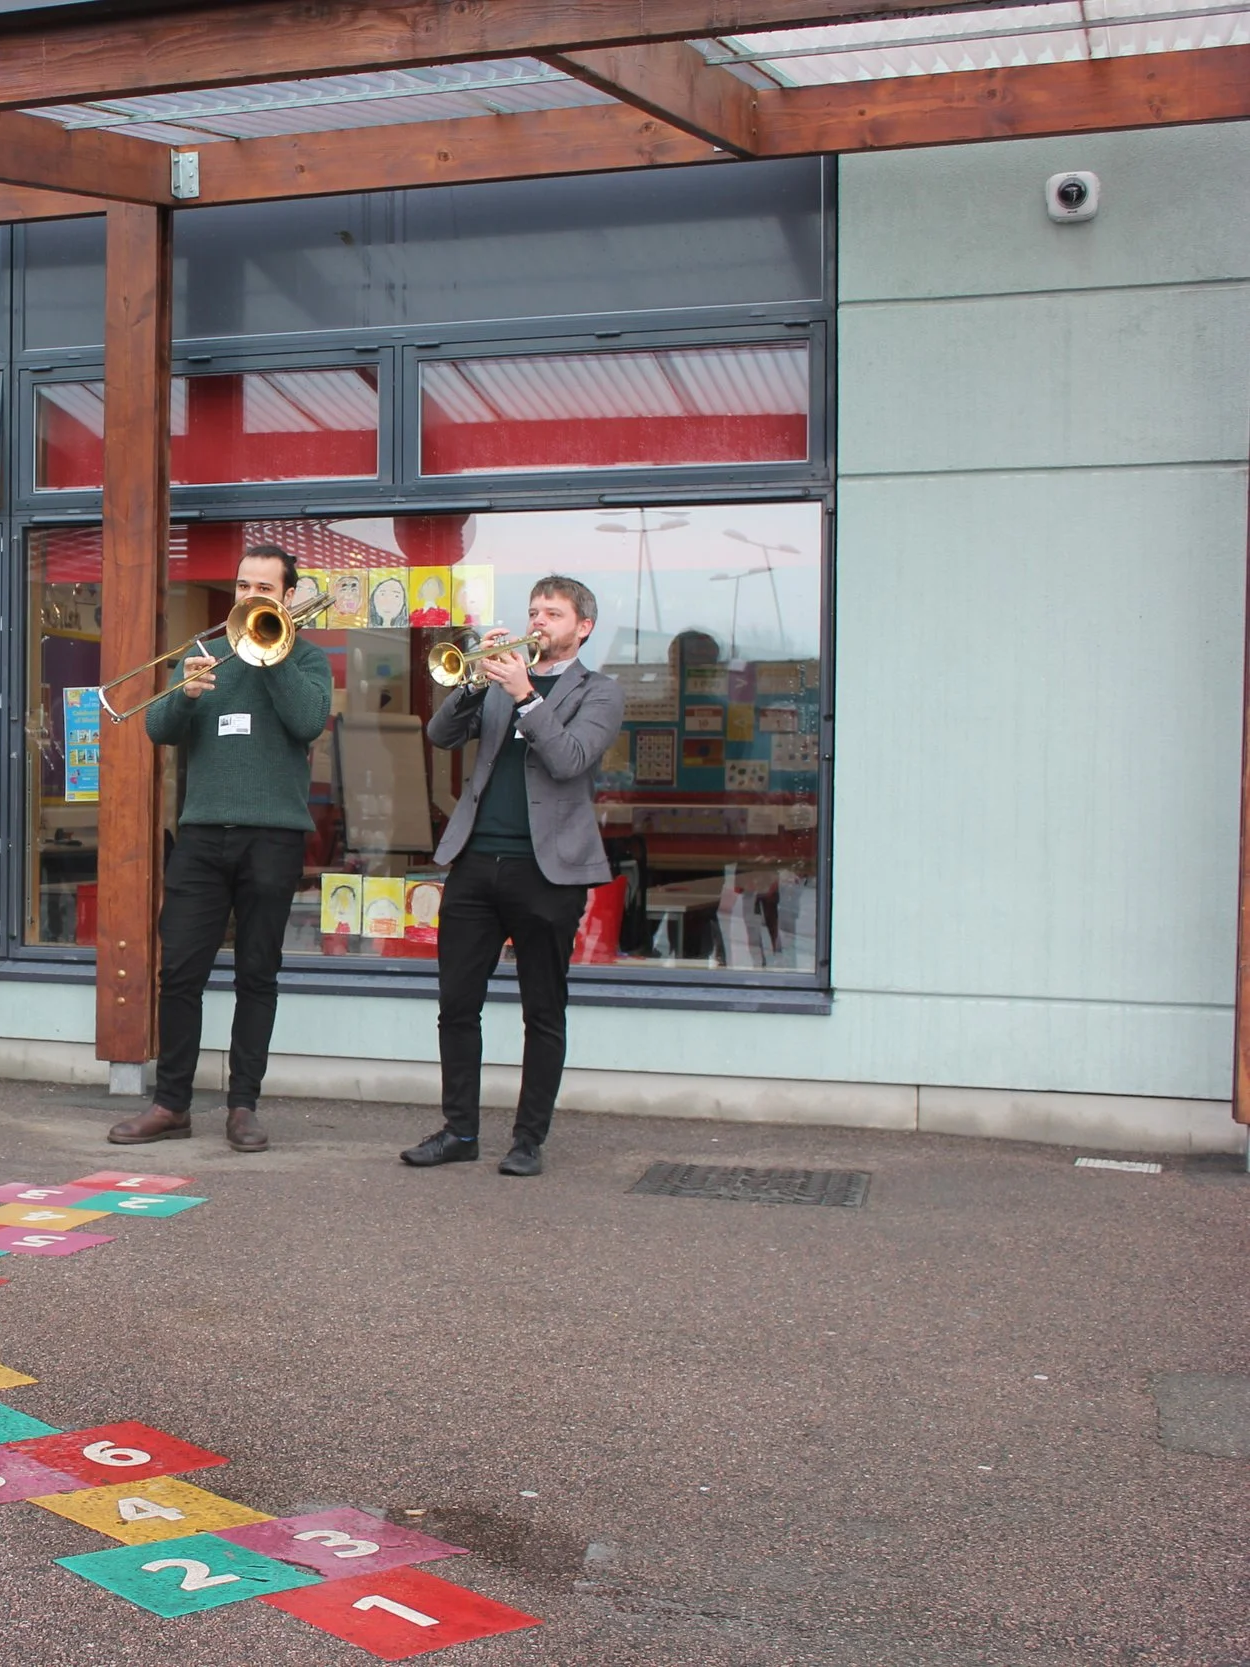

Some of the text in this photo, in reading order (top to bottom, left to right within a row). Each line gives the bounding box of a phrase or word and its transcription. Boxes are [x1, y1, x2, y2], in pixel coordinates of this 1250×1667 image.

[115, 1177, 146, 1187] 1
[17, 1189, 64, 1200] 3
[117, 1197, 166, 1209] 2
[20, 1210, 67, 1221] 4
[11, 1235, 67, 1248] 5
[82, 1440, 151, 1466] 6
[118, 1496, 185, 1521] 4
[294, 1529, 380, 1559] 3
[141, 1558, 242, 1592] 2
[352, 1595, 440, 1627] 1
